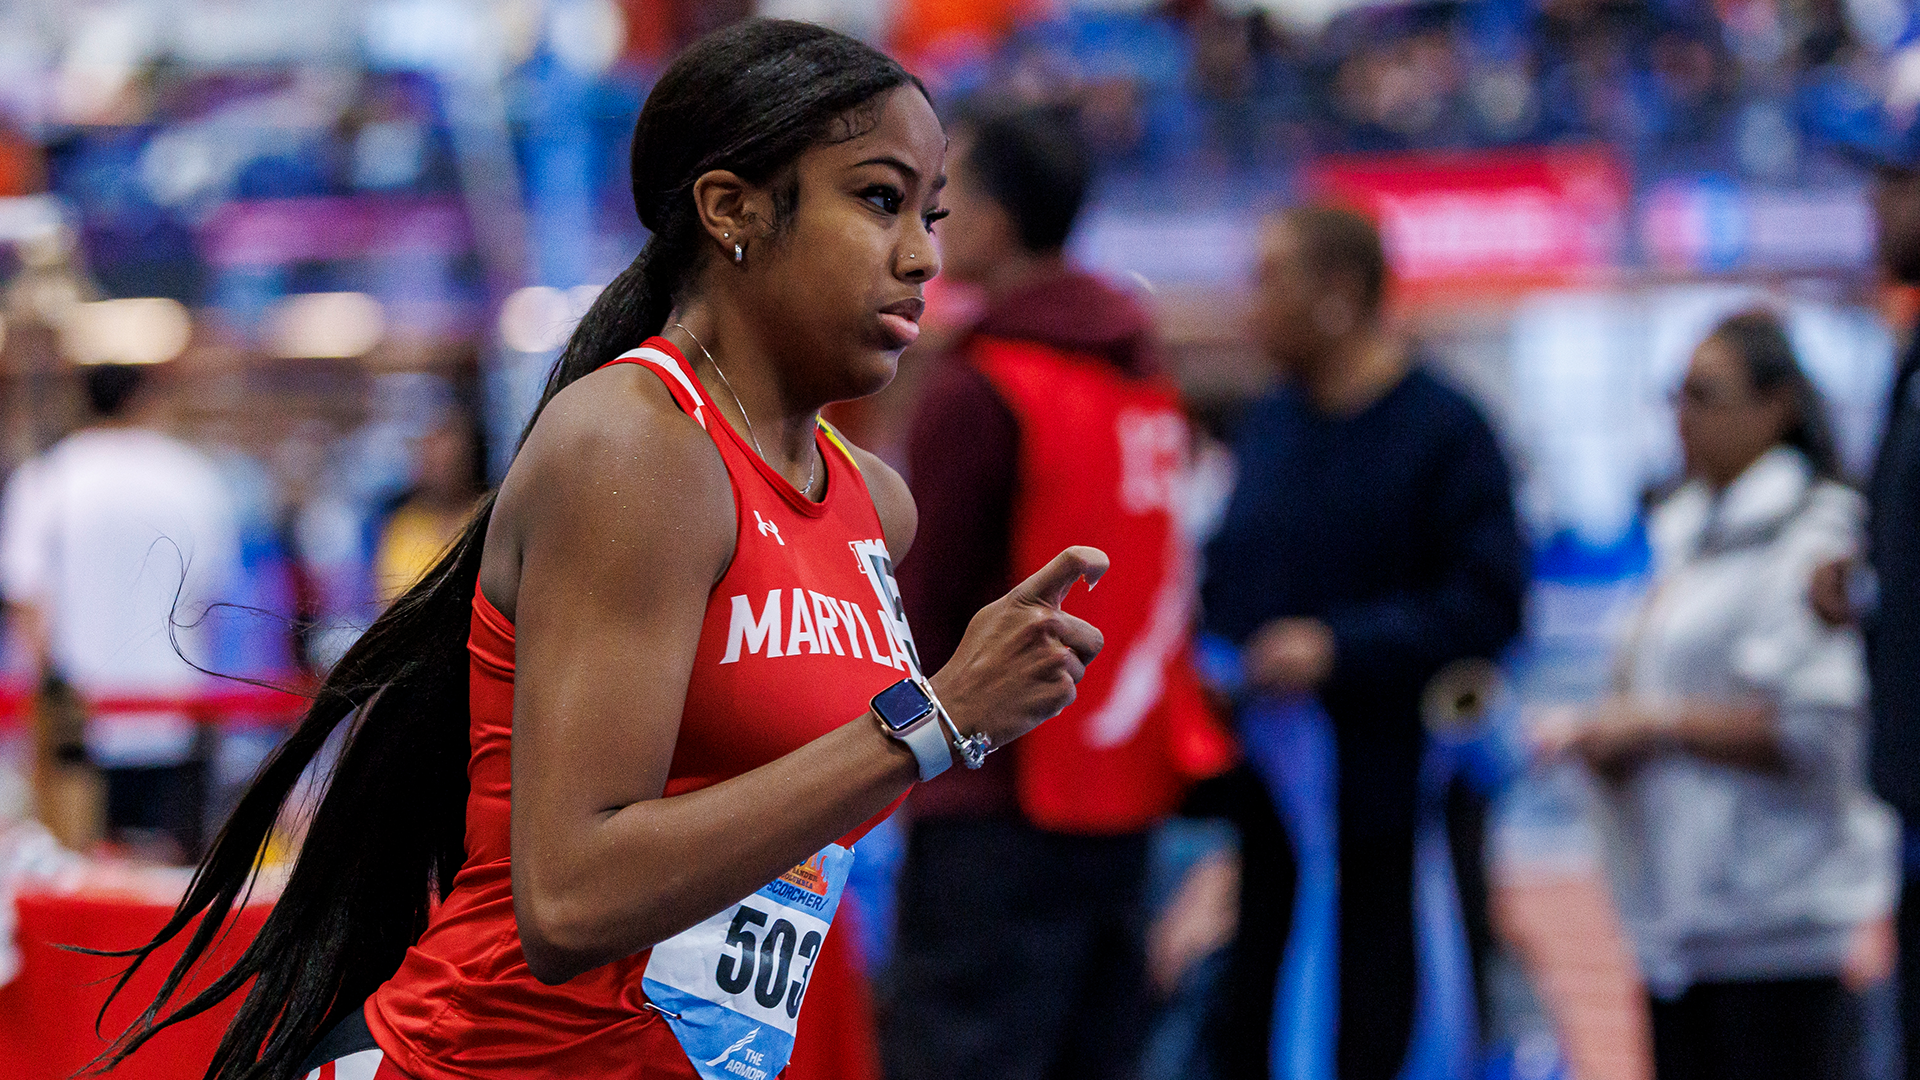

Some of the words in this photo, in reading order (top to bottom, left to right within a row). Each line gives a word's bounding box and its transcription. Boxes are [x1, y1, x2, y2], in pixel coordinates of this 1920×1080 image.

[715, 905, 822, 1019] 503
[745, 1048, 765, 1066] THE
[725, 1059, 768, 1080] ARMORY
